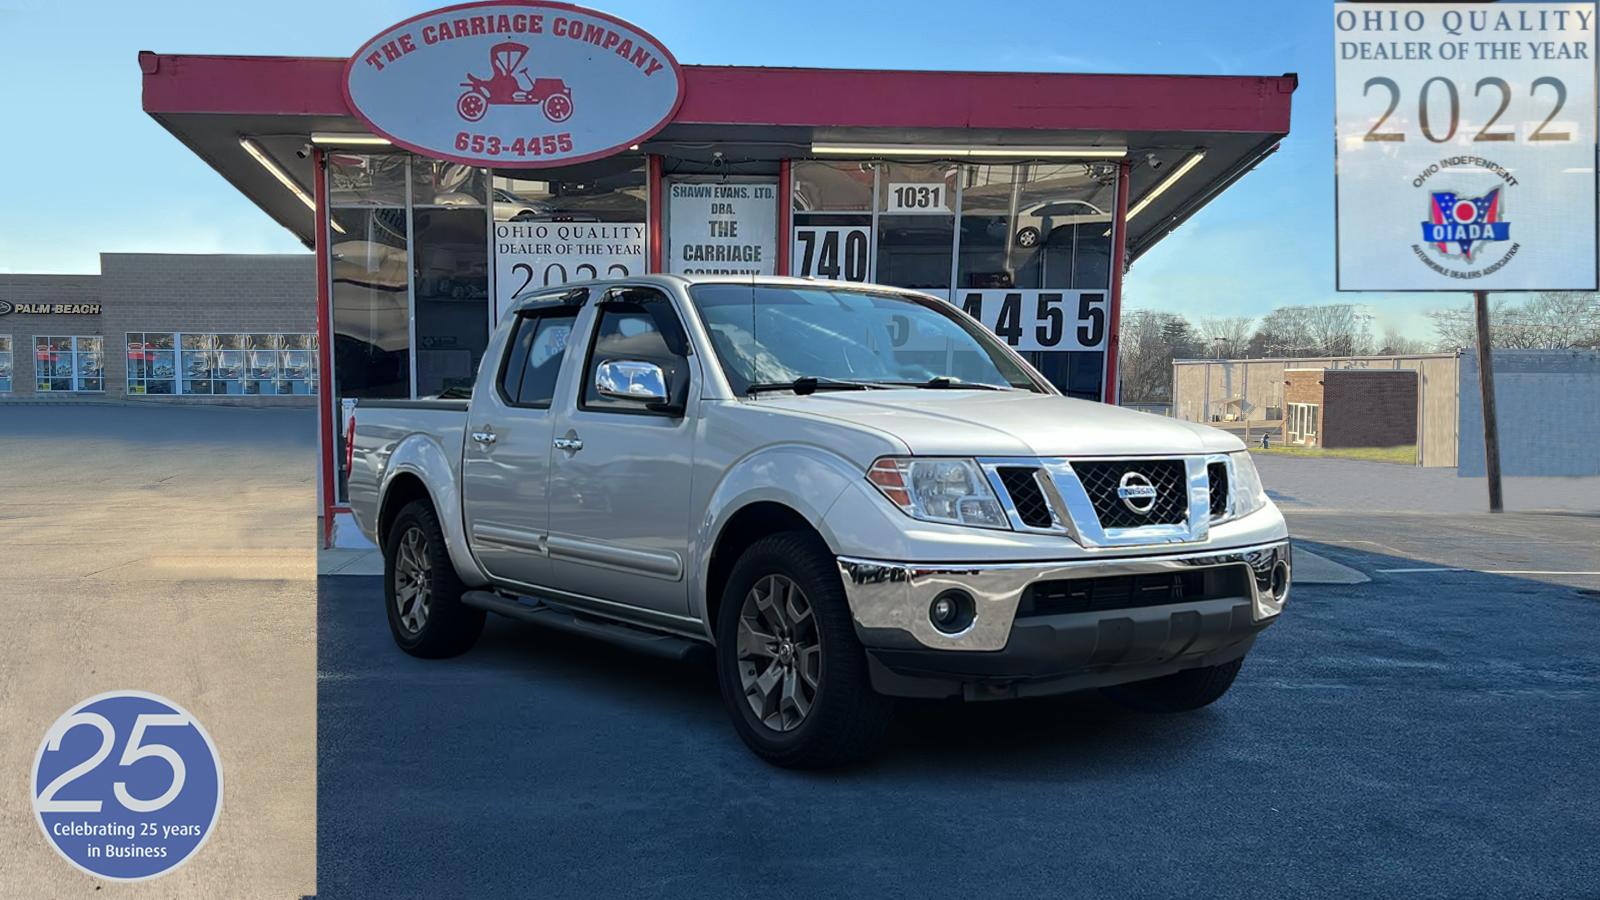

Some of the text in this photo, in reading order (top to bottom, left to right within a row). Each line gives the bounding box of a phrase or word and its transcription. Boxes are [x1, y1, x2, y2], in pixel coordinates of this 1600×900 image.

[1336, 10, 1592, 35] OHIO QUALITY
[365, 14, 664, 77] THE CARRIAGE COMPANY
[1340, 42, 1589, 60] DEALER OF THE YEAR
[1362, 76, 1571, 143] 2022
[454, 132, 573, 157] 653-4455
[1412, 156, 1519, 188] OHIO INDEPENDENT
[673, 186, 712, 198] SHAWN
[754, 187, 775, 199] LTD.
[894, 187, 940, 208] 1031
[711, 203, 736, 215] DBA.
[497, 226, 644, 240] OHIO QUALITY
[708, 220, 738, 238] THE
[1432, 225, 1495, 241] OIADA
[499, 243, 642, 255] DEALER OF THE YEAR
[682, 245, 762, 262] CARRIAGE
[797, 230, 868, 282] 740
[1411, 242, 1521, 279] AUTOMOBILE DEALERS ASSOCIATION
[15, 304, 100, 313] PALM BEACH
